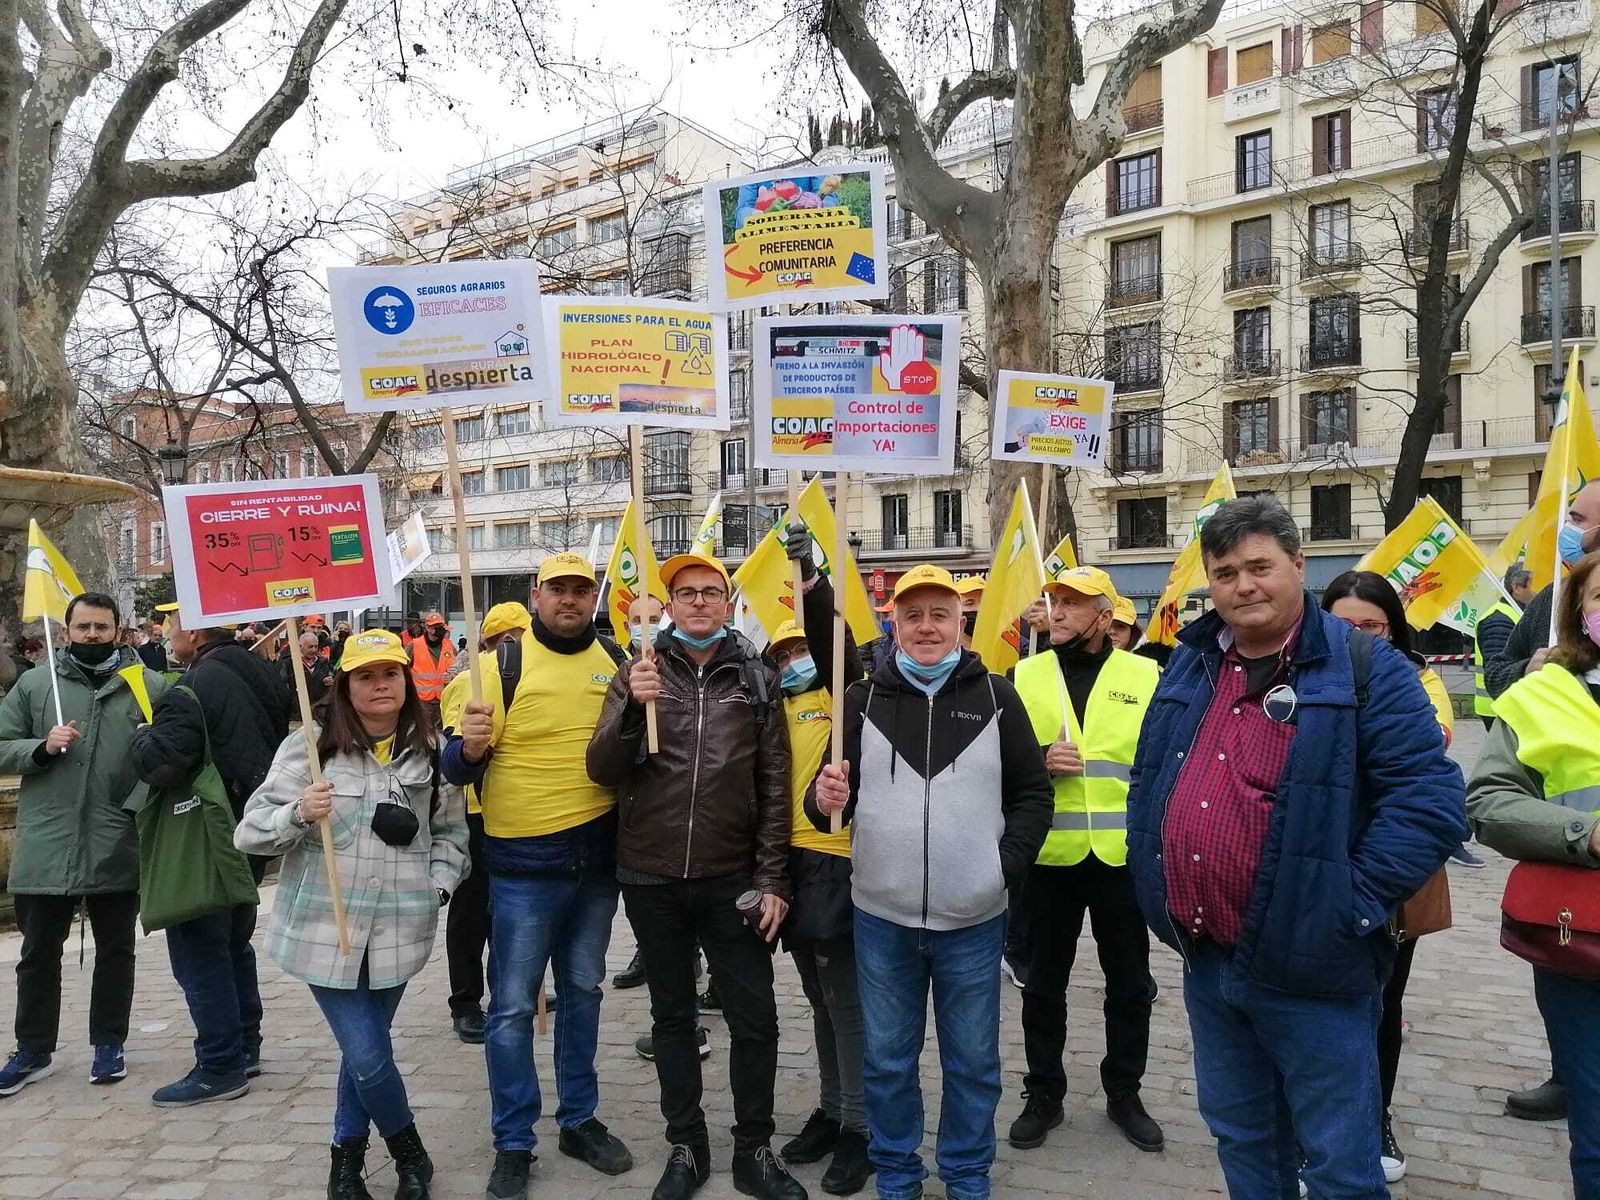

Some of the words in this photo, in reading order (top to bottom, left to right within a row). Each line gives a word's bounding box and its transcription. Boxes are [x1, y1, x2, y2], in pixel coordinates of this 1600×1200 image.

[738, 220, 856, 239] ALIMENTARIA
[760, 238, 834, 255] PREFERENCIA
[760, 255, 837, 273] COMUNITARIA
[776, 272, 812, 283] COAG
[416, 285, 457, 296] SEGUROS
[460, 281, 506, 292] AGRARIOS
[419, 296, 507, 317] EFICACES
[563, 313, 632, 323] INVERSIONES
[635, 316, 665, 326] PARA
[668, 318, 681, 327] EL
[685, 320, 712, 330] AGUA
[591, 339, 632, 347] PLAN
[561, 349, 662, 361] HIDROLÓGICO
[775, 362, 801, 371] FRENO
[802, 362, 808, 370] A
[809, 362, 819, 370] LA
[819, 360, 865, 370] INVASIÓN
[369, 376, 418, 389] COAG
[425, 364, 534, 390] despierta
[793, 374, 841, 382] PRODUCTOS
[845, 373, 856, 381] DE
[903, 375, 934, 384] STOP
[783, 386, 823, 394] TERCEROS
[1035, 386, 1077, 399] COAG
[568, 393, 612, 404] COAG
[647, 401, 701, 414] despierta
[847, 401, 901, 414] Control
[906, 401, 924, 414] de
[771, 417, 833, 435] COAG
[834, 420, 937, 436] Importaciones
[1050, 414, 1087, 430] EXIGE
[872, 440, 895, 452] YA!
[1031, 436, 1054, 445] PRECIOS
[230, 499, 253, 507] SIN
[254, 494, 323, 506] RENTABILIDAD
[200, 507, 271, 524] CIERRE
[276, 505, 294, 517] Y
[297, 500, 362, 516] RUINA!
[273, 586, 310, 598] COAG
[1466, 607, 1478, 628] UPA
[1109, 690, 1138, 702] COAG
